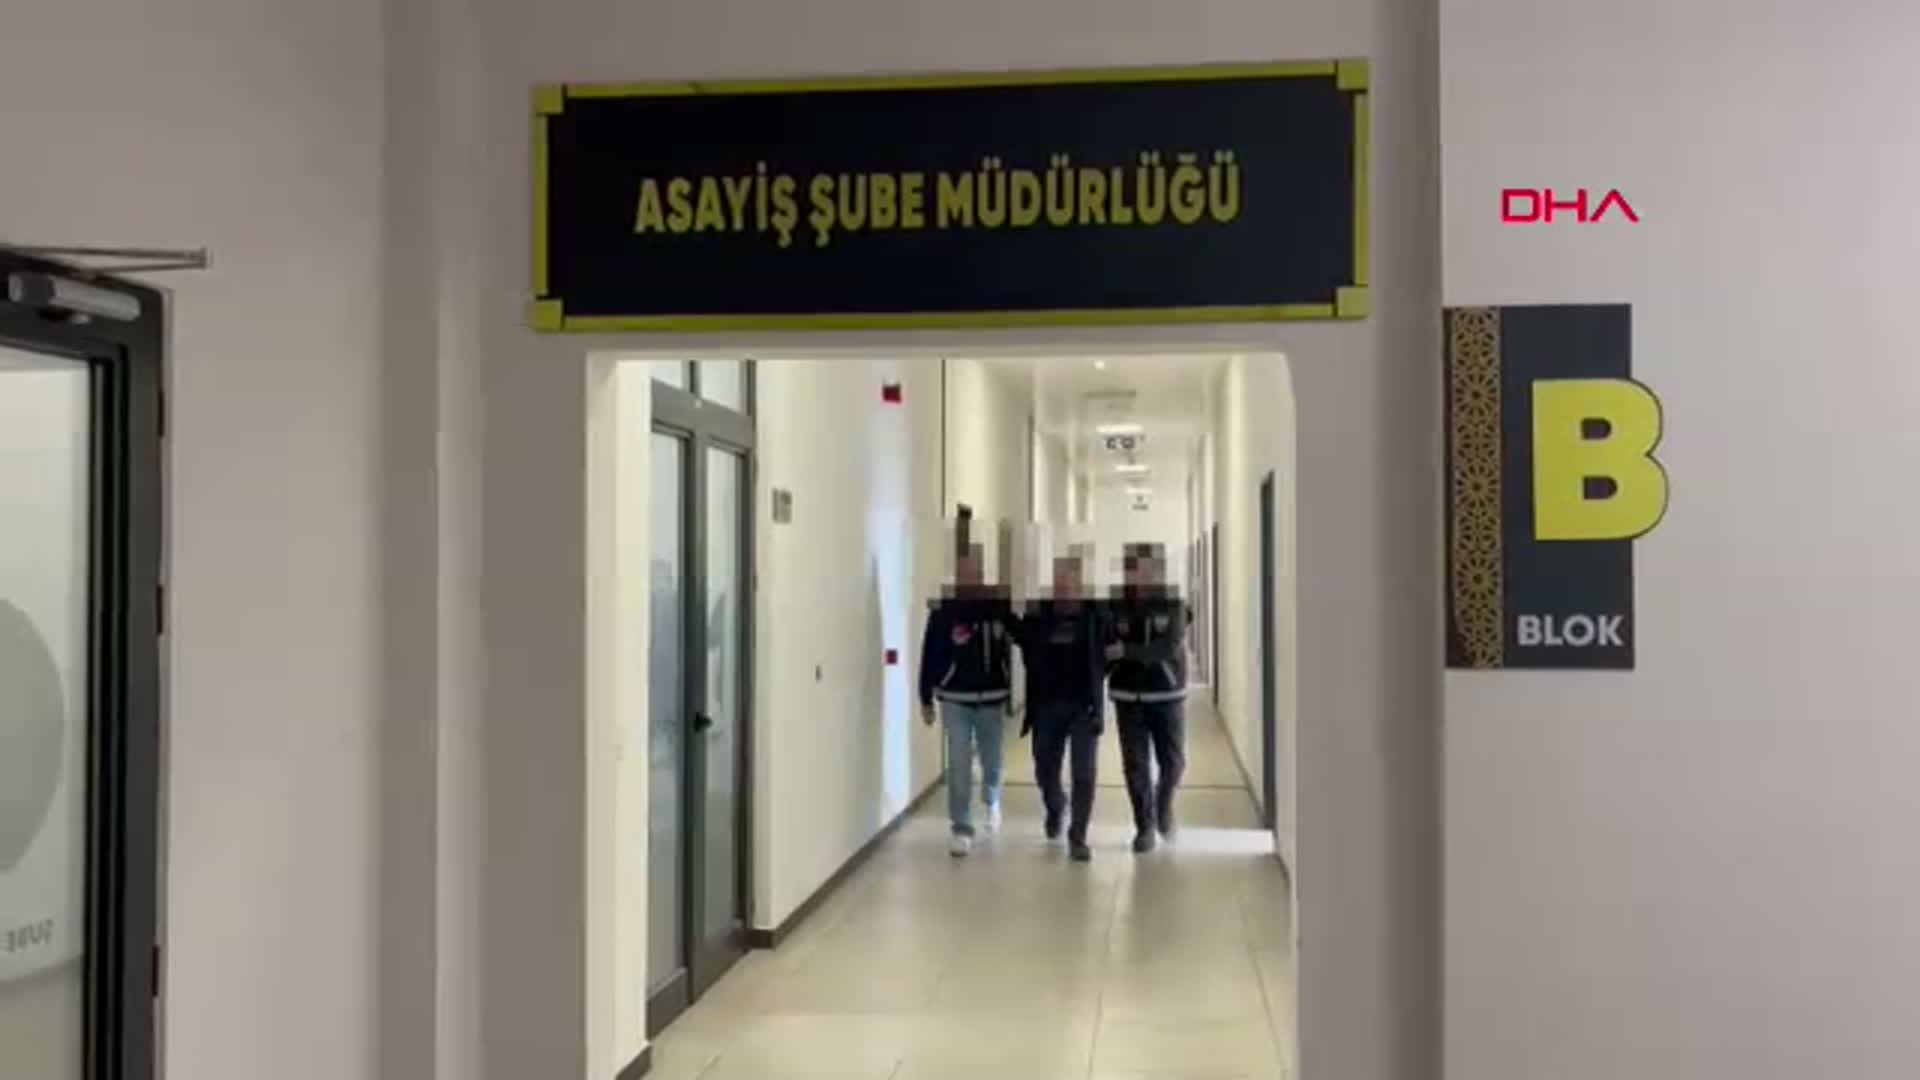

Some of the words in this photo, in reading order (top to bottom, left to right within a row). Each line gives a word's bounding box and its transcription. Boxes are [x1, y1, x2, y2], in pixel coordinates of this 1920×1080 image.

[634, 160, 798, 248] ASAYİŞ
[808, 172, 925, 248] ŞUBE
[937, 149, 1240, 229] MÜDÜRLÜĞÜ
[1532, 377, 1669, 540] B
[1517, 615, 1624, 646] BLOK
